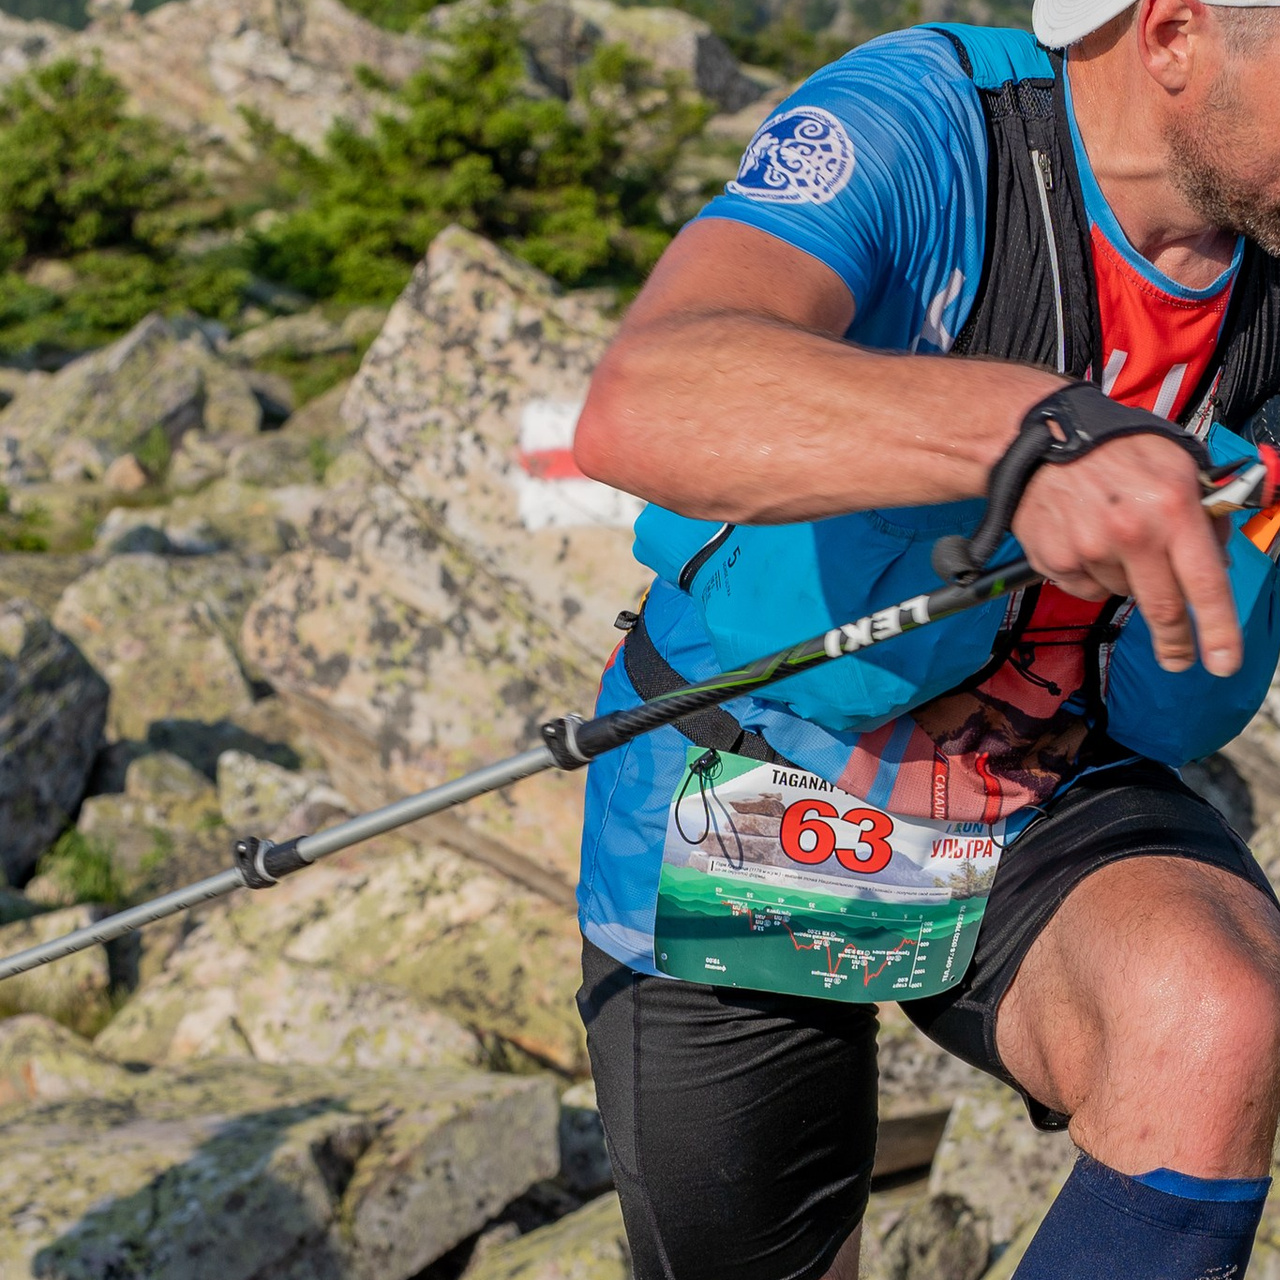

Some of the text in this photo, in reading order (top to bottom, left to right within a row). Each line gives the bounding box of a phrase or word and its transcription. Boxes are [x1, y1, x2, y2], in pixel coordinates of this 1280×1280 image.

[728, 545, 741, 568] 5
[834, 594, 931, 658] LEKI
[780, 798, 894, 874] 63
[931, 839, 993, 859] УЛЬТРА
